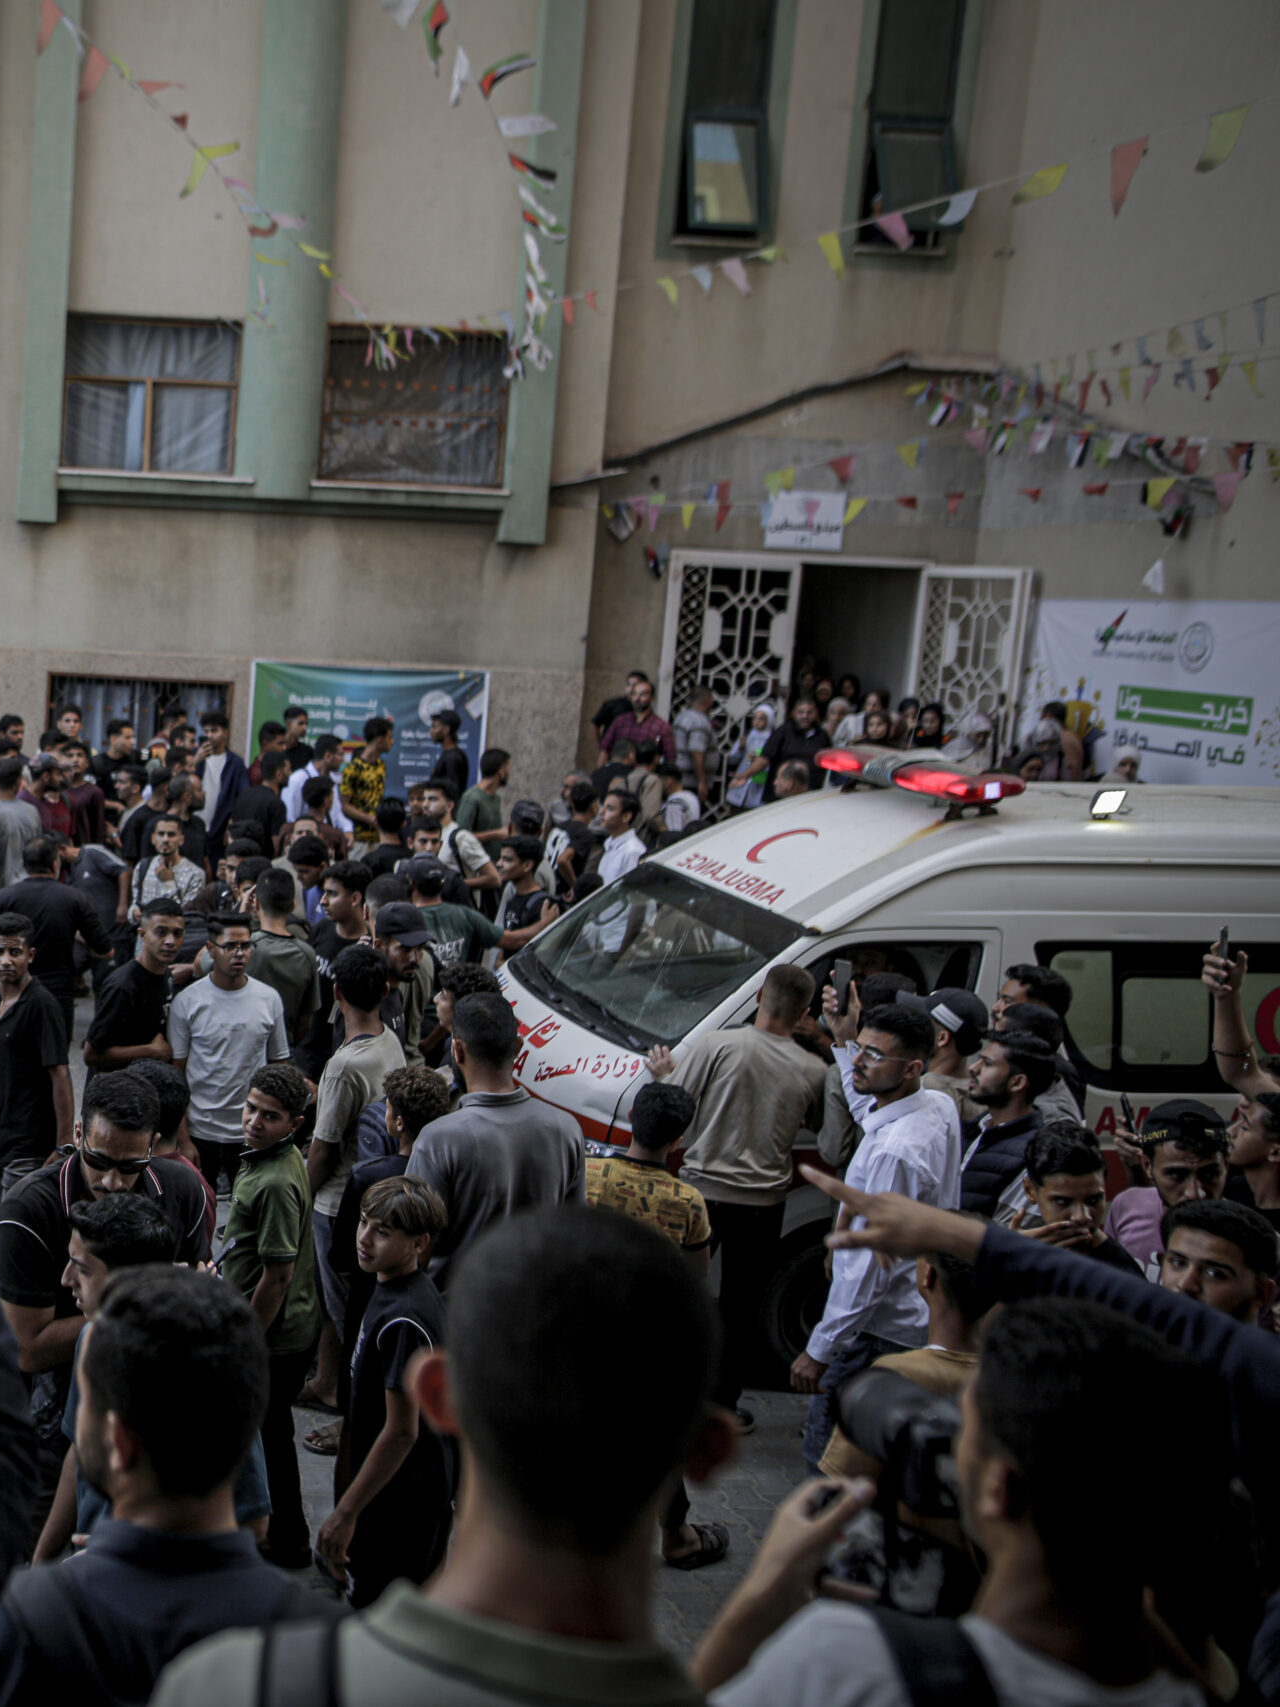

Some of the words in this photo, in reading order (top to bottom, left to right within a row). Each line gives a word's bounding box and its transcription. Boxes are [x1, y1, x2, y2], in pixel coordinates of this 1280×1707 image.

[1119, 687, 1249, 731] خريجونا
[1207, 744, 1246, 768] في
[534, 1057, 589, 1082] الصحة
[591, 1054, 640, 1079] وزارة
